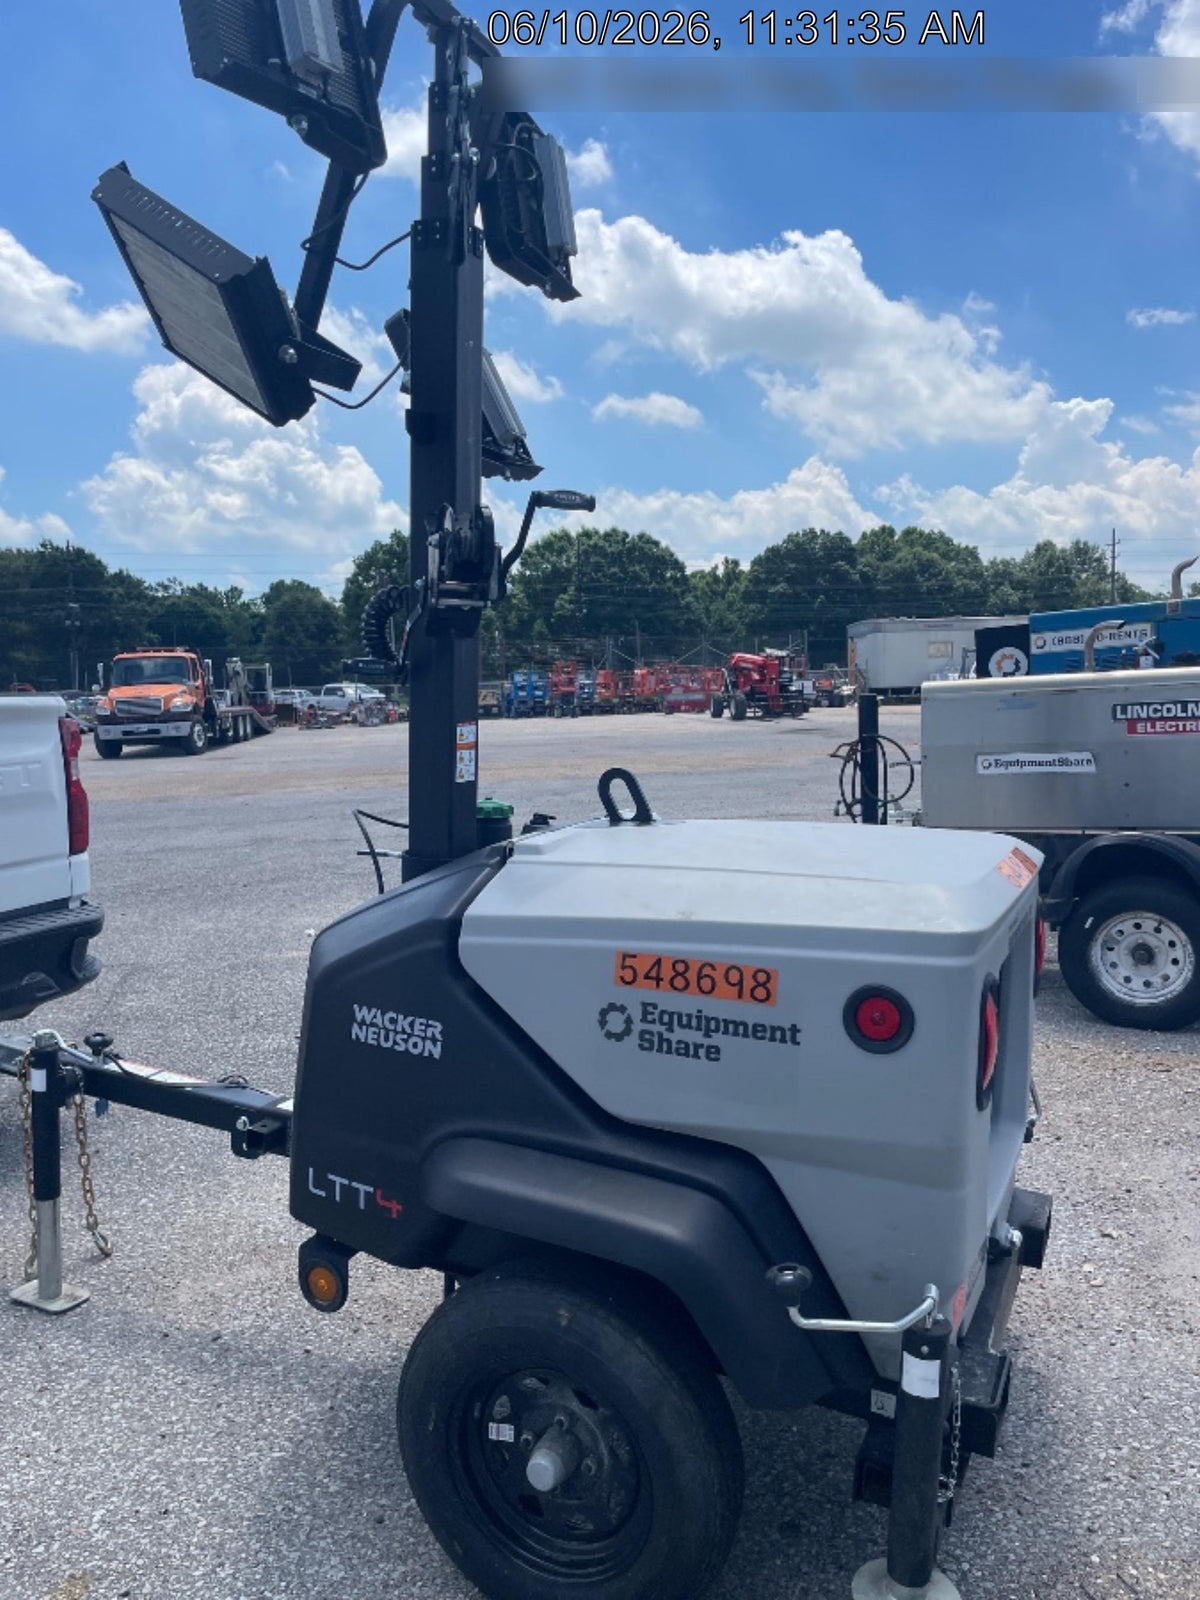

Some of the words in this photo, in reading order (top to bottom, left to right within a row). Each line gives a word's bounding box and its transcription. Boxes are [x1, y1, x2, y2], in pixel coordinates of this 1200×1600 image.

[1116, 703, 1200, 719] LINCOLN
[619, 953, 773, 1002] 548698
[352, 1004, 444, 1041] WACKER
[639, 1001, 802, 1046] Equipment
[351, 1024, 443, 1060] NEUSON
[638, 1029, 722, 1062] Share
[308, 1167, 404, 1218] LTT4
